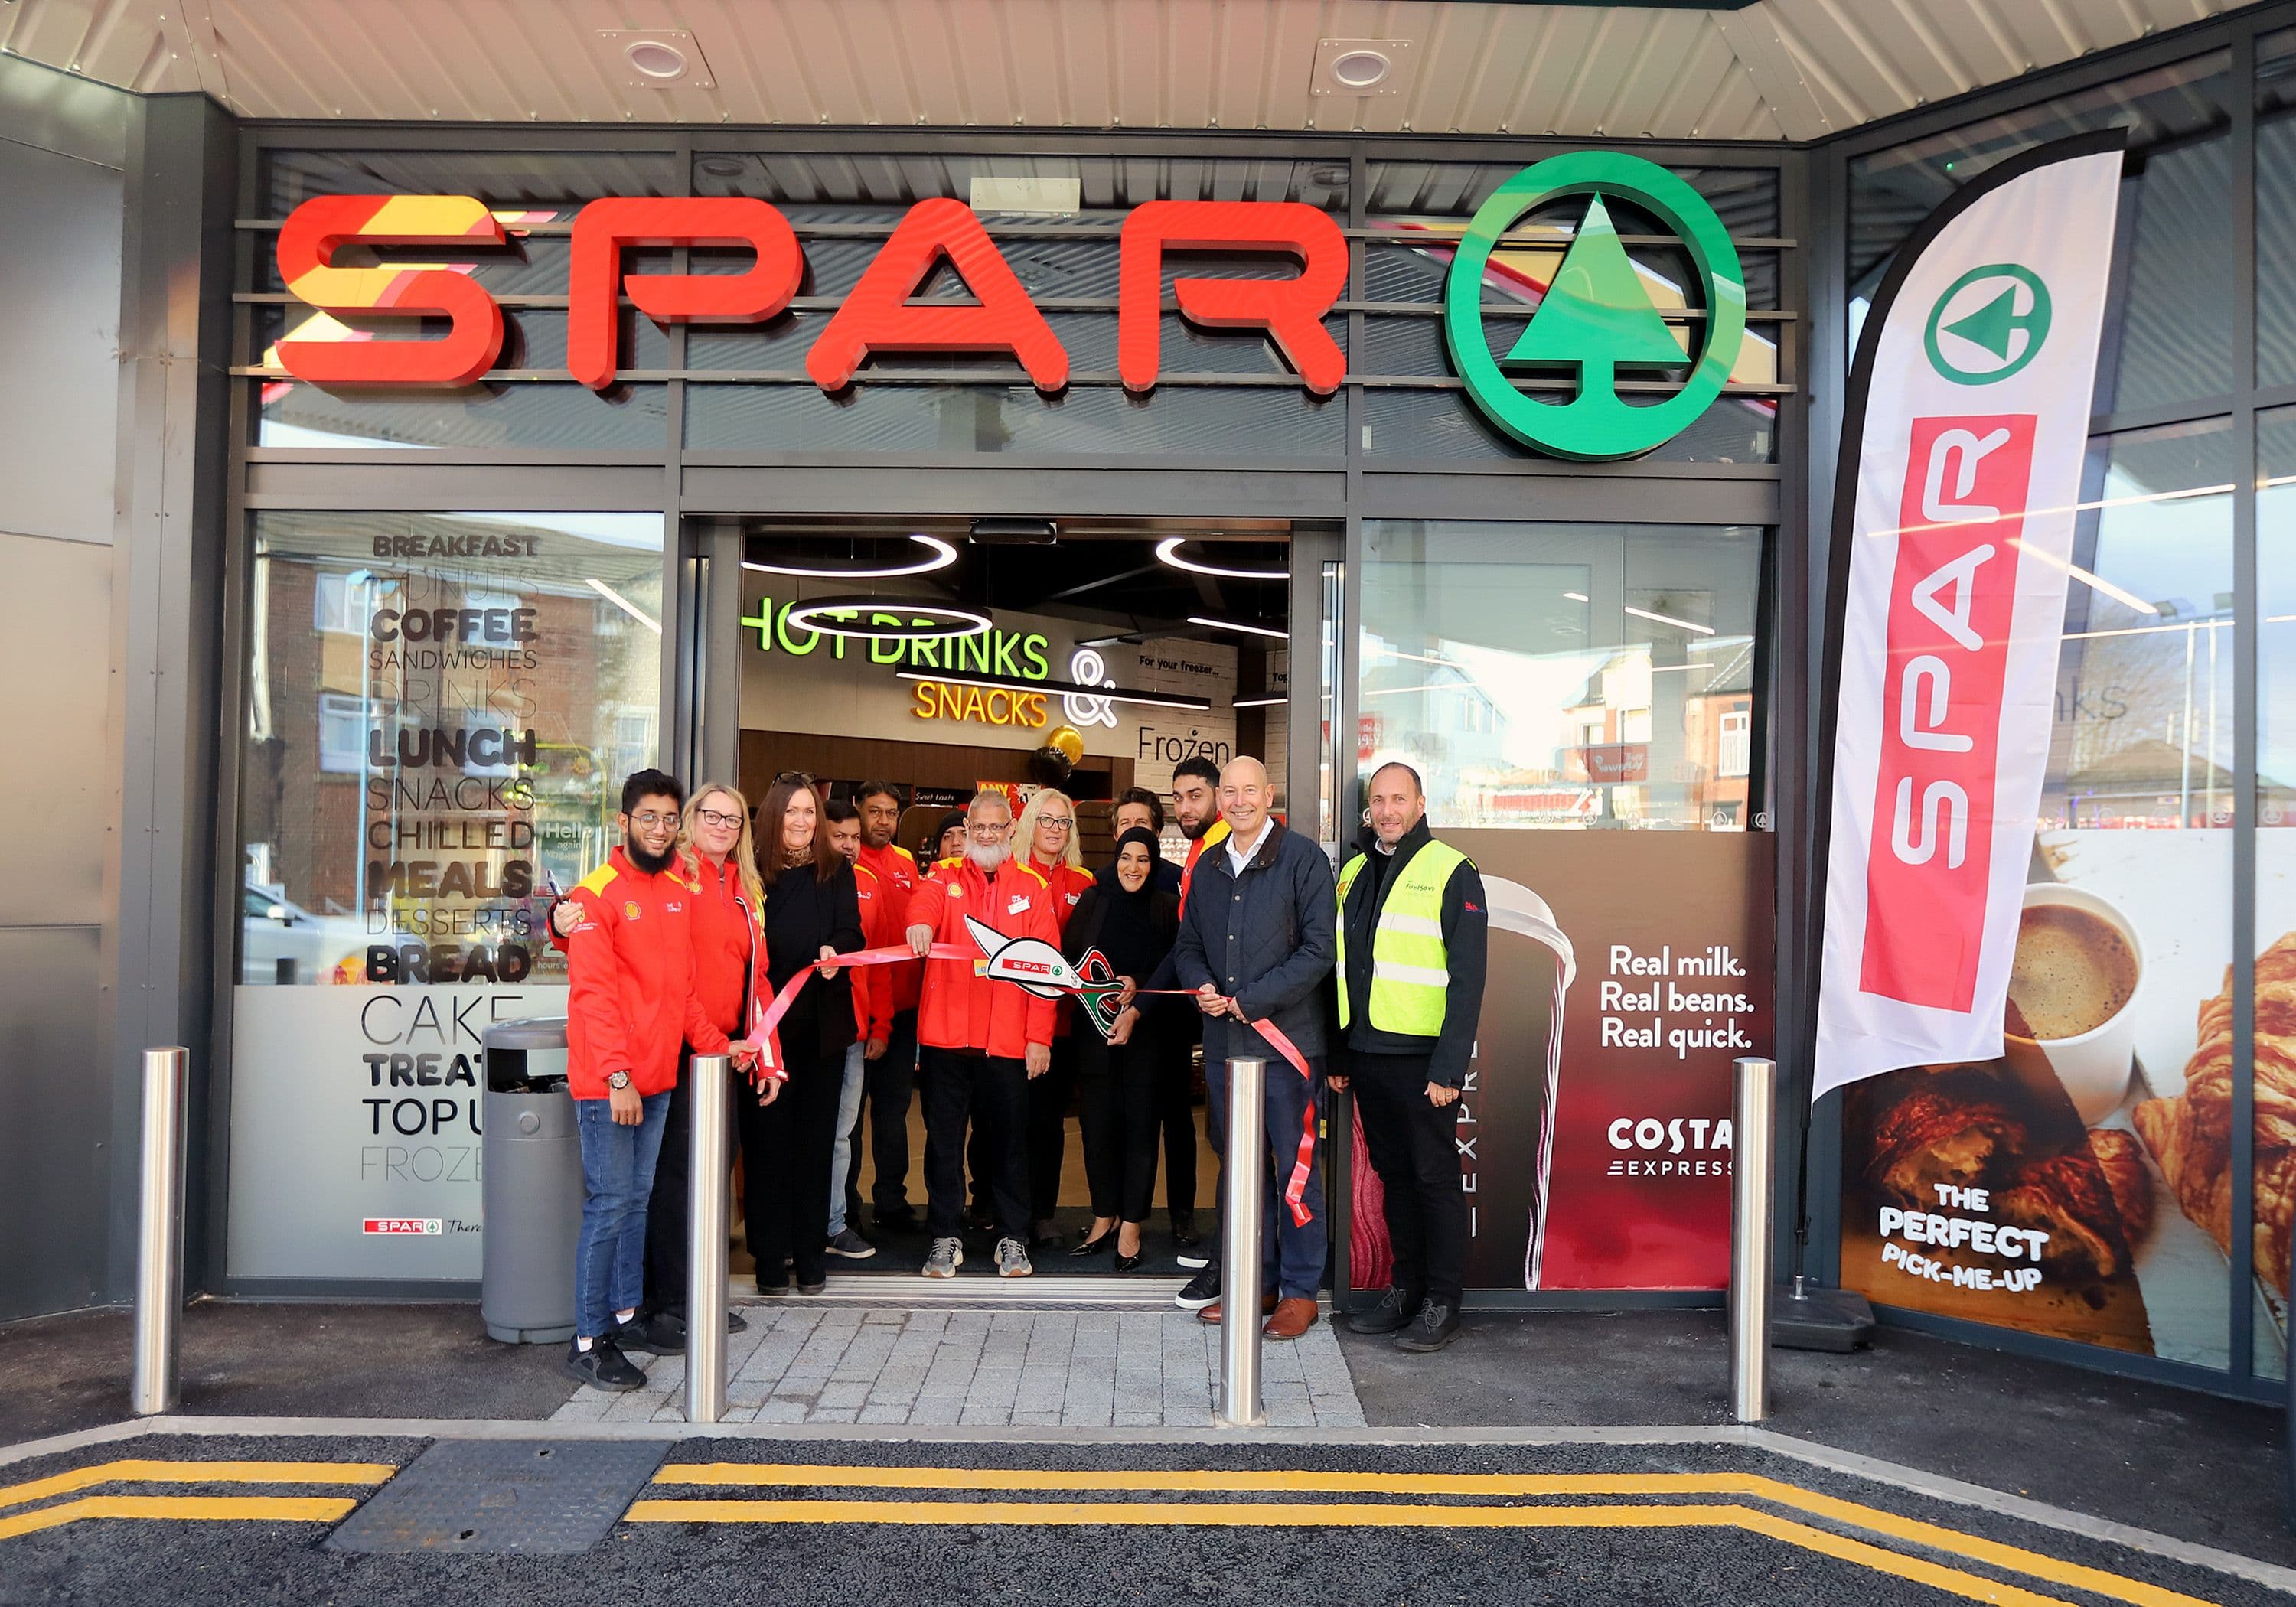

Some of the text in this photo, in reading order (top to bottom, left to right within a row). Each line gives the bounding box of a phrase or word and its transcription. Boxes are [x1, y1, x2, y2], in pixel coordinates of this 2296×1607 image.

[276, 194, 1349, 395] SPAR
[373, 535, 539, 558] BREAKFAST
[369, 568, 540, 602] DONUTS
[370, 608, 538, 643] COFFEE
[740, 597, 859, 660] HOT
[871, 613, 1049, 681] DRINKS
[369, 650, 537, 670] SANDWICHES
[1140, 655, 1155, 667] For
[1157, 658, 1178, 671] your
[1891, 427, 2011, 870] SPAR
[368, 678, 537, 719] DRINKS
[914, 680, 1049, 729] SNACKS
[369, 728, 536, 768] LUNCH
[1139, 726, 1229, 764] Frozen
[367, 776, 535, 812] SNACKS
[915, 792, 933, 801] Sweet
[367, 820, 536, 852] CHILLED
[546, 822, 595, 839] Hello
[557, 841, 582, 851] again
[367, 860, 533, 900] MEALS
[367, 908, 532, 936] DESSERTS
[367, 944, 532, 983] BREAD
[537, 961, 560, 970] hours
[1013, 961, 1050, 973] SPAR
[1610, 945, 1746, 977] Real milk.
[1601, 981, 1755, 1013] Real beans.
[1601, 1017, 1753, 1060] Real quick.
[362, 1098, 458, 1136] TOP
[1607, 1117, 1733, 1155] COSTA
[1932, 1182, 1990, 1213] THE
[377, 1221, 423, 1231] SPAR
[1879, 1206, 2050, 1263] PERFECT
[1881, 1241, 2043, 1293] PICK-ME-UP
